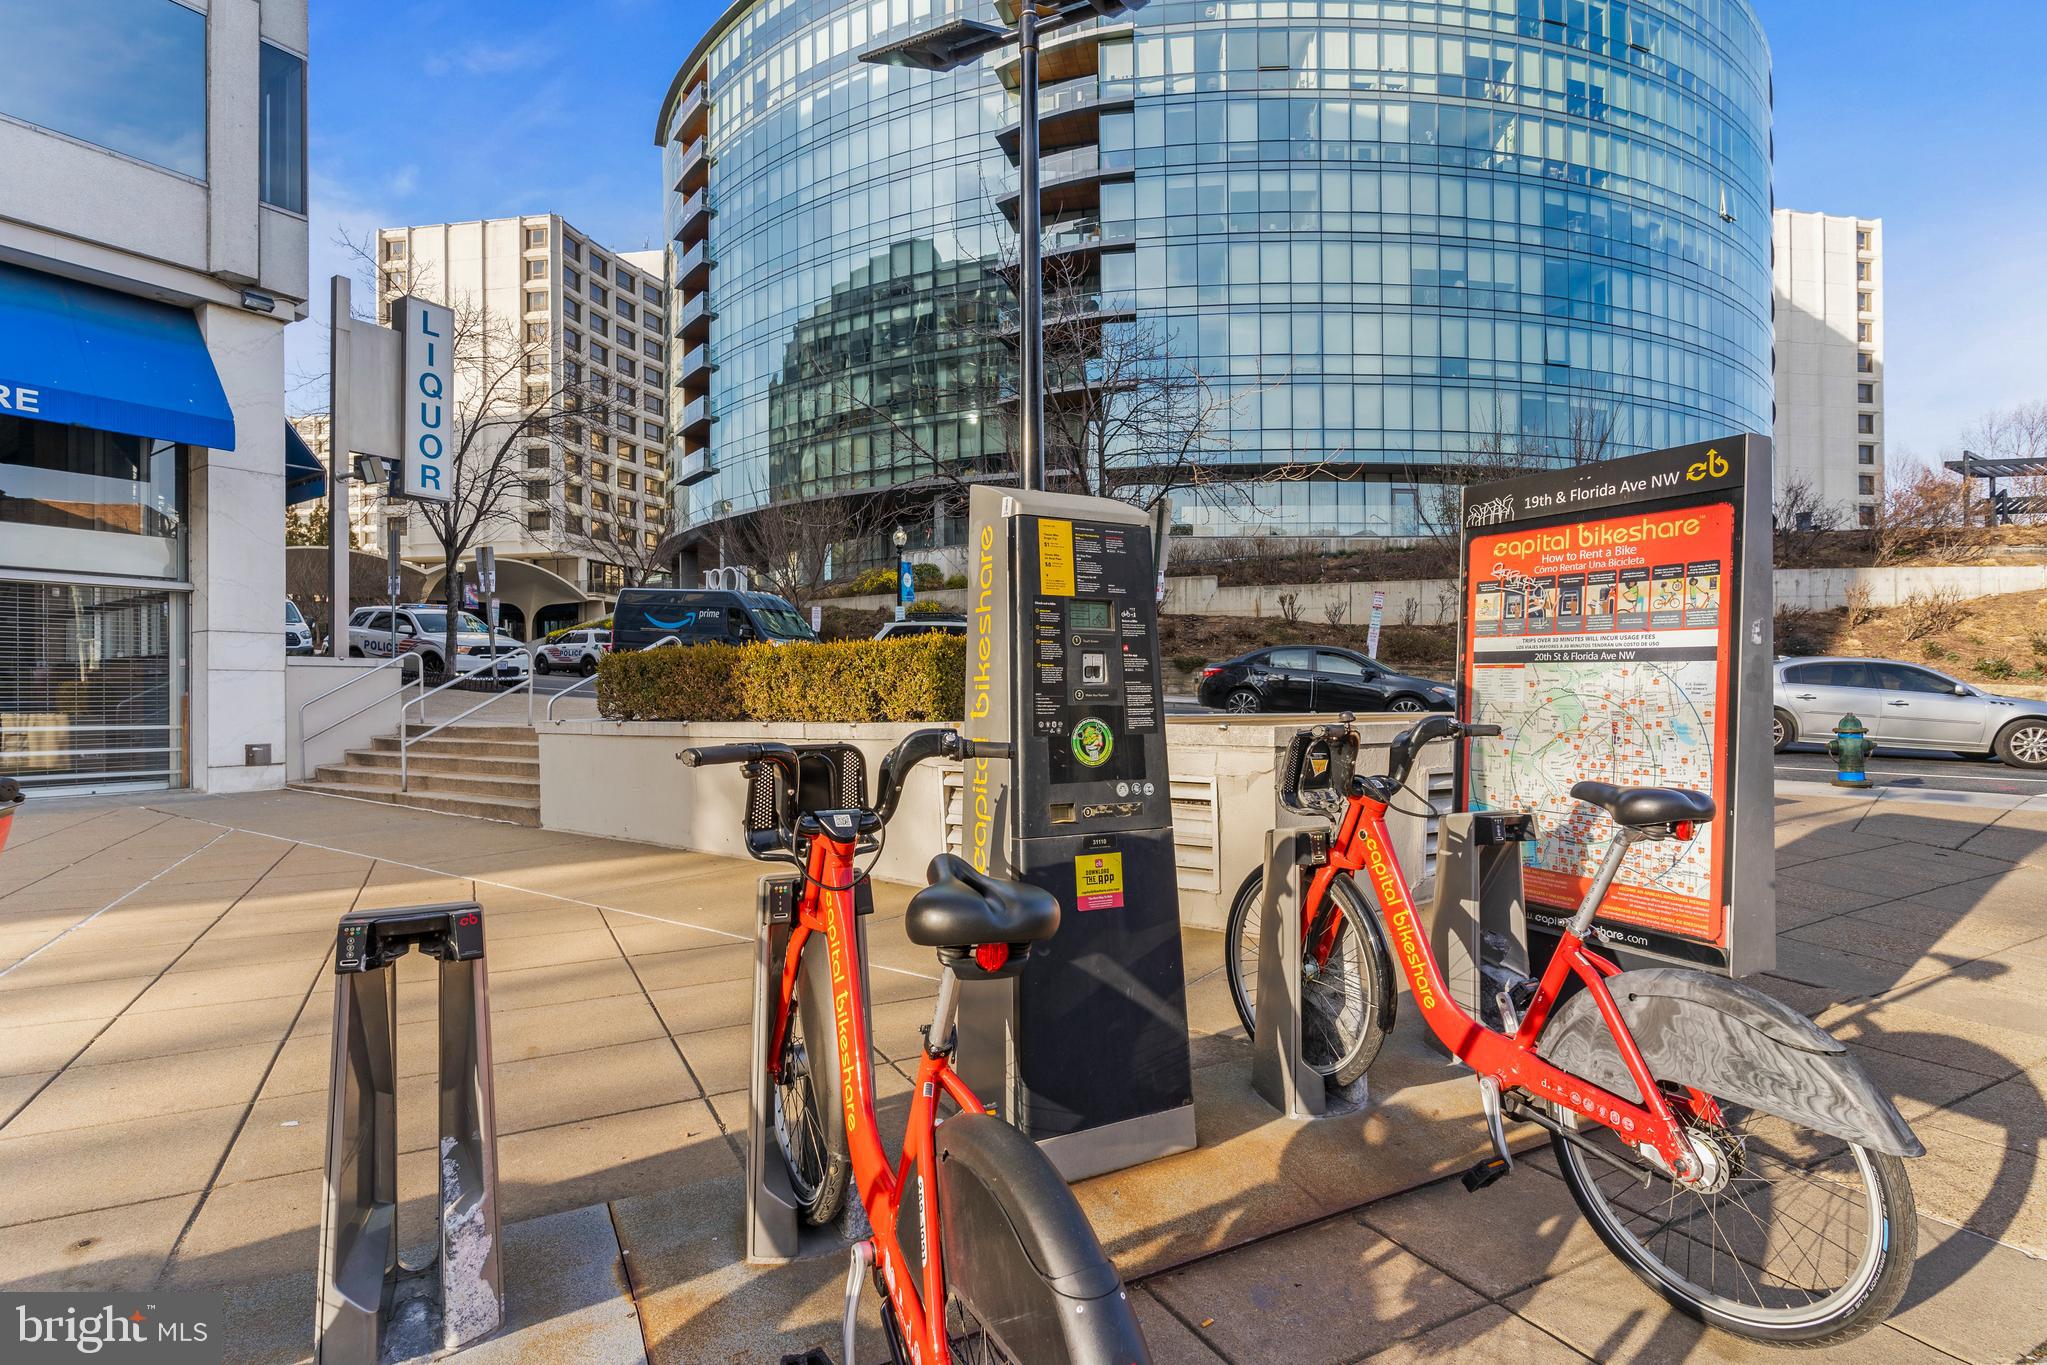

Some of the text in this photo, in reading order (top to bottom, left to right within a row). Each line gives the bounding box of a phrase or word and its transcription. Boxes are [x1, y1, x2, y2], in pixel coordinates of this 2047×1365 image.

[419, 310, 442, 491] LIQUOR
[1524, 494, 1552, 509] 19th
[1556, 491, 1566, 503] &
[1570, 485, 1616, 502] Florida
[1620, 479, 1647, 494] Ave
[1651, 471, 1680, 488] NW
[1493, 517, 1701, 559] capital bikeshare
[1541, 553, 1564, 564] How
[1566, 551, 1577, 561] to
[1579, 549, 1603, 560] Rent
[1614, 545, 1637, 556] Bike
[1560, 562, 1587, 572] Rentar
[1589, 560, 1606, 569] Una
[1608, 556, 1645, 567] Bicicleta
[698, 608, 720, 620] prime
[970, 524, 994, 719] bikeshare
[559, 649, 582, 657] POLICE
[1534, 650, 1636, 661] 20th St & Florida Ave NW
[1085, 868, 1110, 876] DOWNLOAD
[1098, 873, 1115, 885] APP
[1365, 838, 1436, 1010] capital bikeshare
[826, 891, 856, 1132] capital bikeshare
